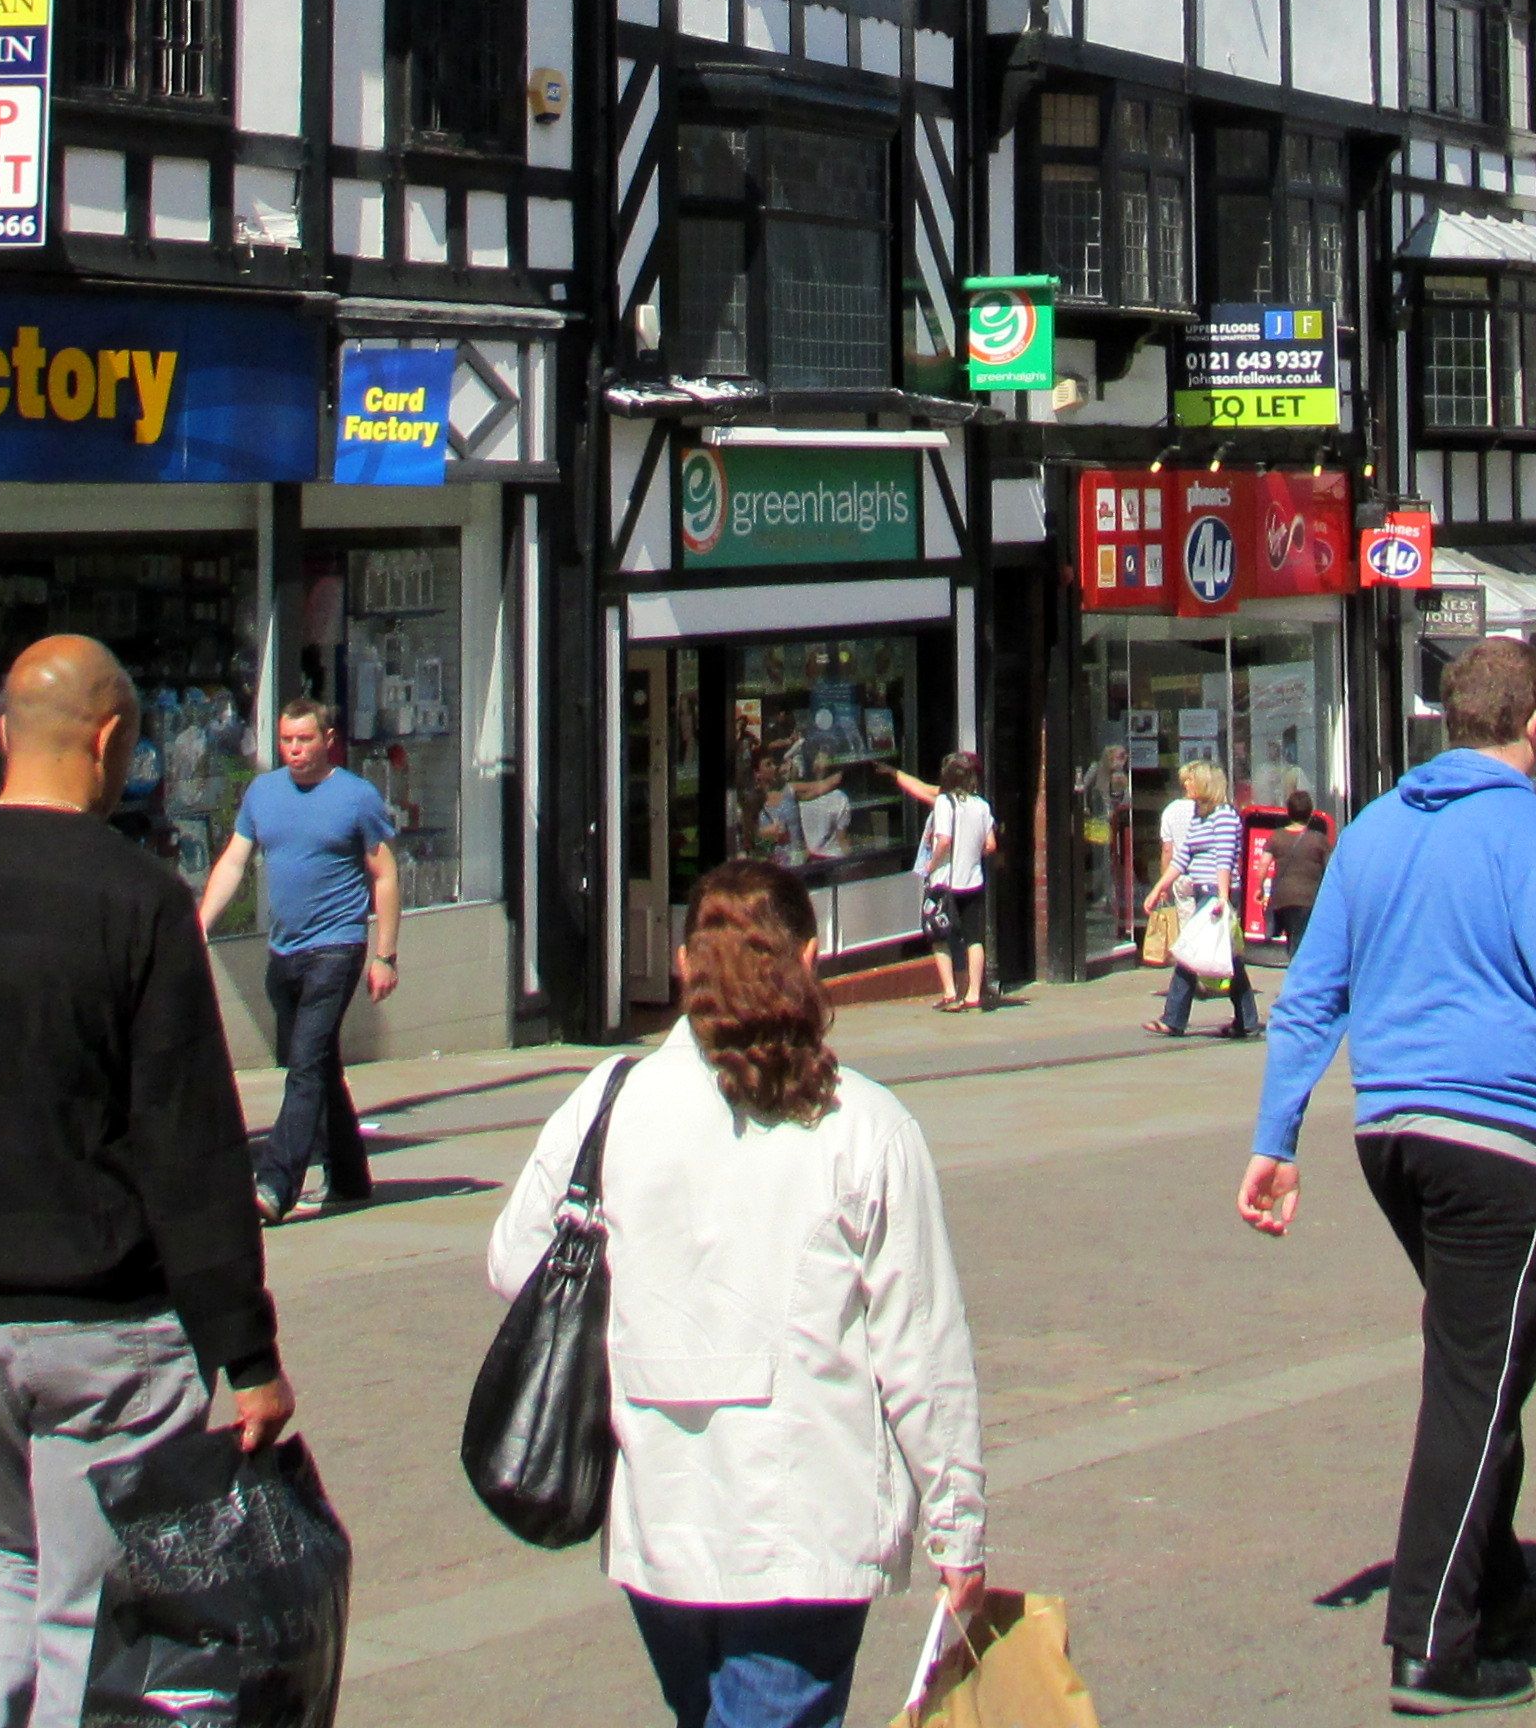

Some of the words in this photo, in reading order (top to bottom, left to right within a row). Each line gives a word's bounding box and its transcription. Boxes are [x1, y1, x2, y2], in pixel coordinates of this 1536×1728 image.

[1185, 324, 1218, 334] UPPER
[1219, 323, 1261, 334] FLOORS
[1275, 315, 1283, 336] J
[1302, 315, 1313, 334] F
[1186, 352, 1230, 370] 0121
[1236, 351, 1272, 370] 643
[1275, 350, 1324, 370] 9337
[1188, 370, 1323, 387] johnsonfellows.co.uk
[364, 386, 426, 412] Card
[1203, 395, 1245, 418] TO
[1256, 395, 1306, 417] LET
[344, 415, 440, 448] Factory
[732, 480, 909, 536] greenhalgh's
[1192, 523, 1232, 596] 4u
